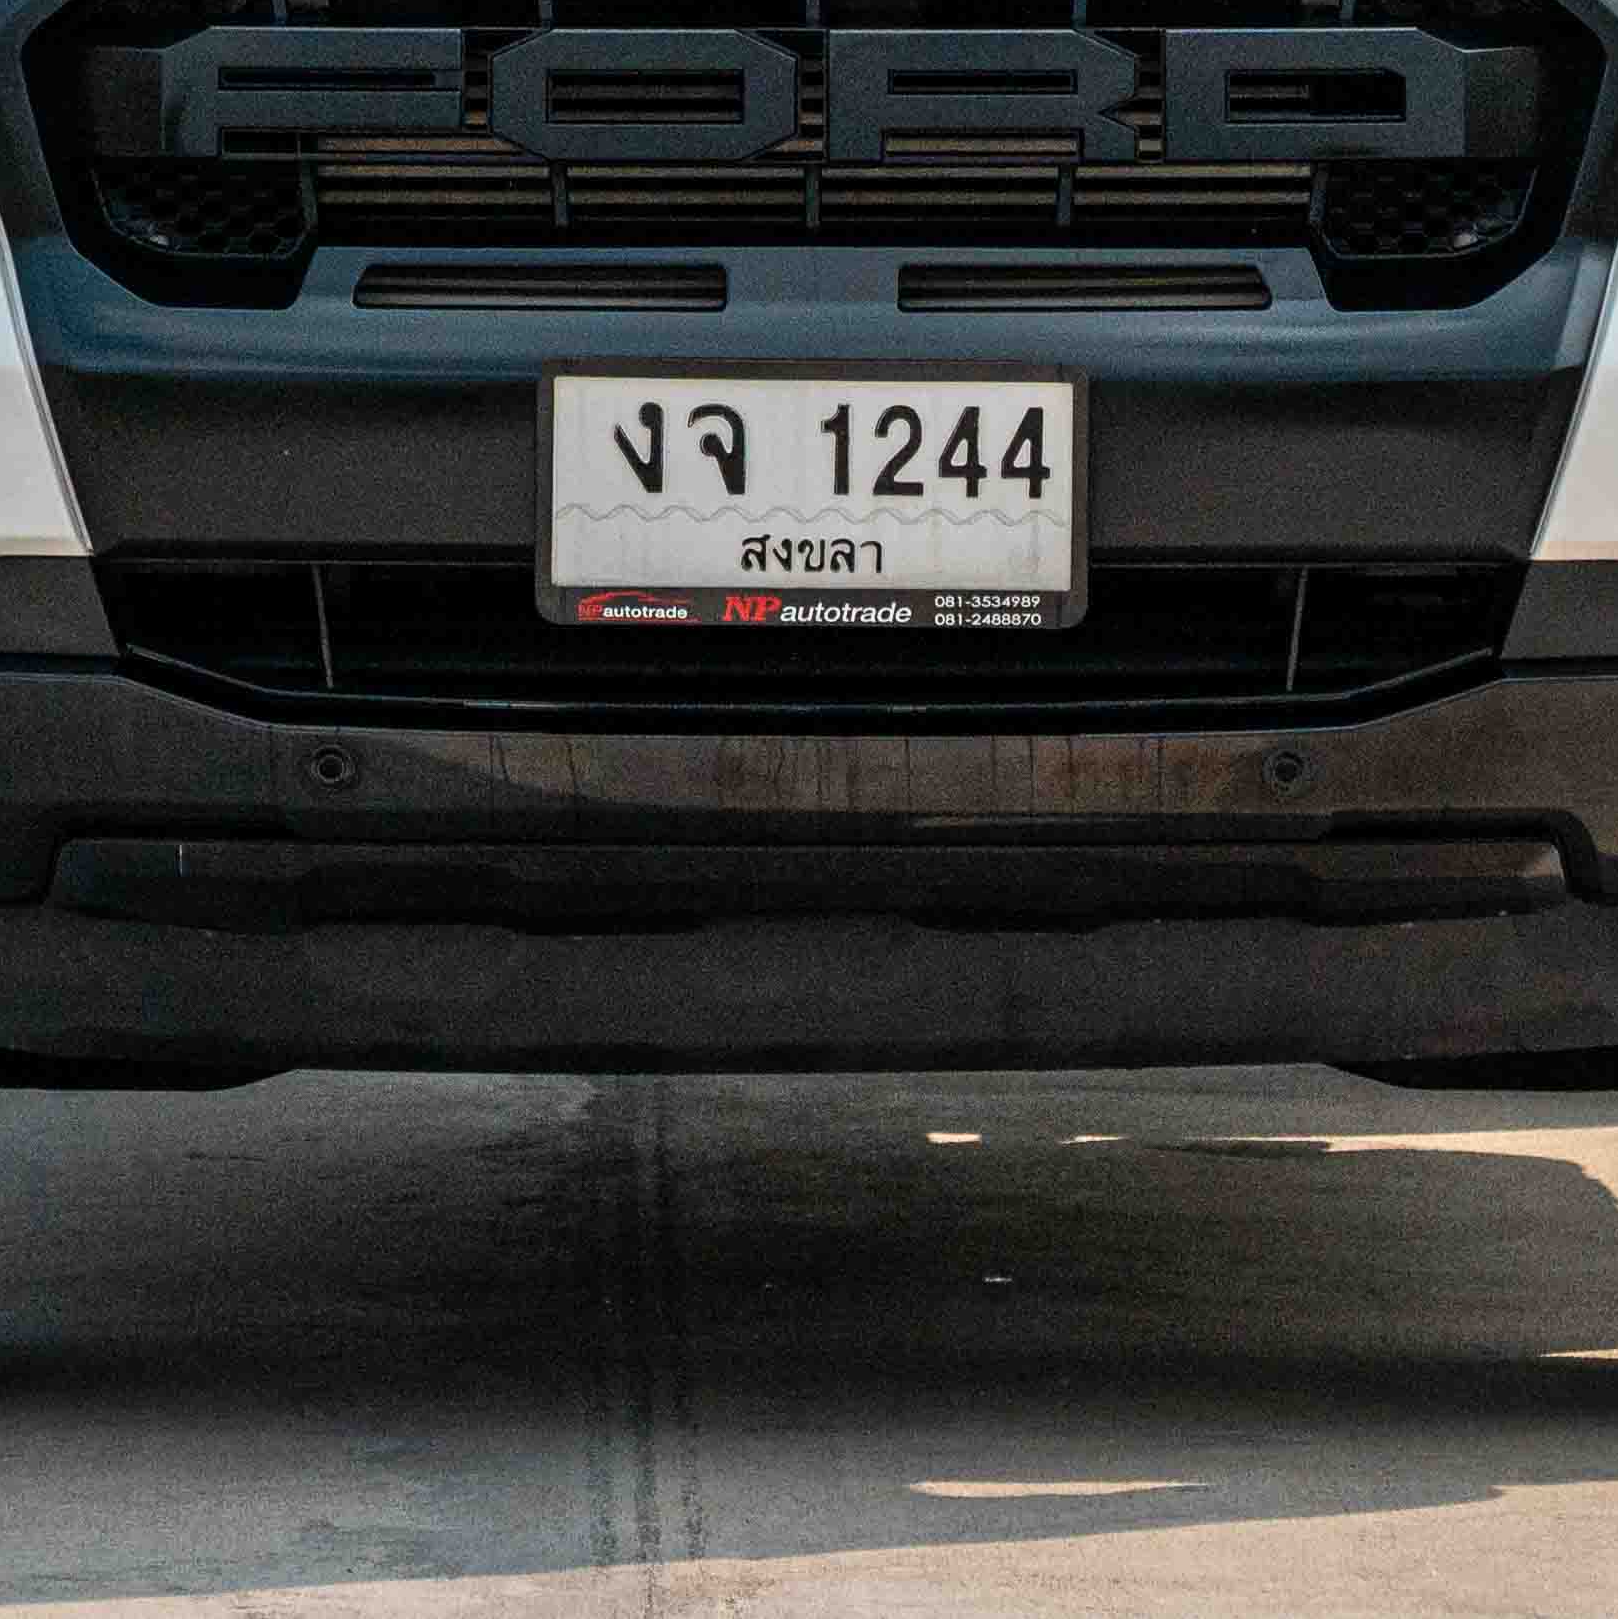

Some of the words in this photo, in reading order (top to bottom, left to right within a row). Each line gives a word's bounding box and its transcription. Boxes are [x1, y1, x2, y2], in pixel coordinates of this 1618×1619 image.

[161, 25, 1466, 161] FORD
[613, 401, 746, 495] งจ
[820, 402, 1051, 499] 1244
[740, 535, 884, 573] สงขลา
[934, 594, 1041, 609] 081-3534989
[934, 612, 1042, 627] 081-2488870
